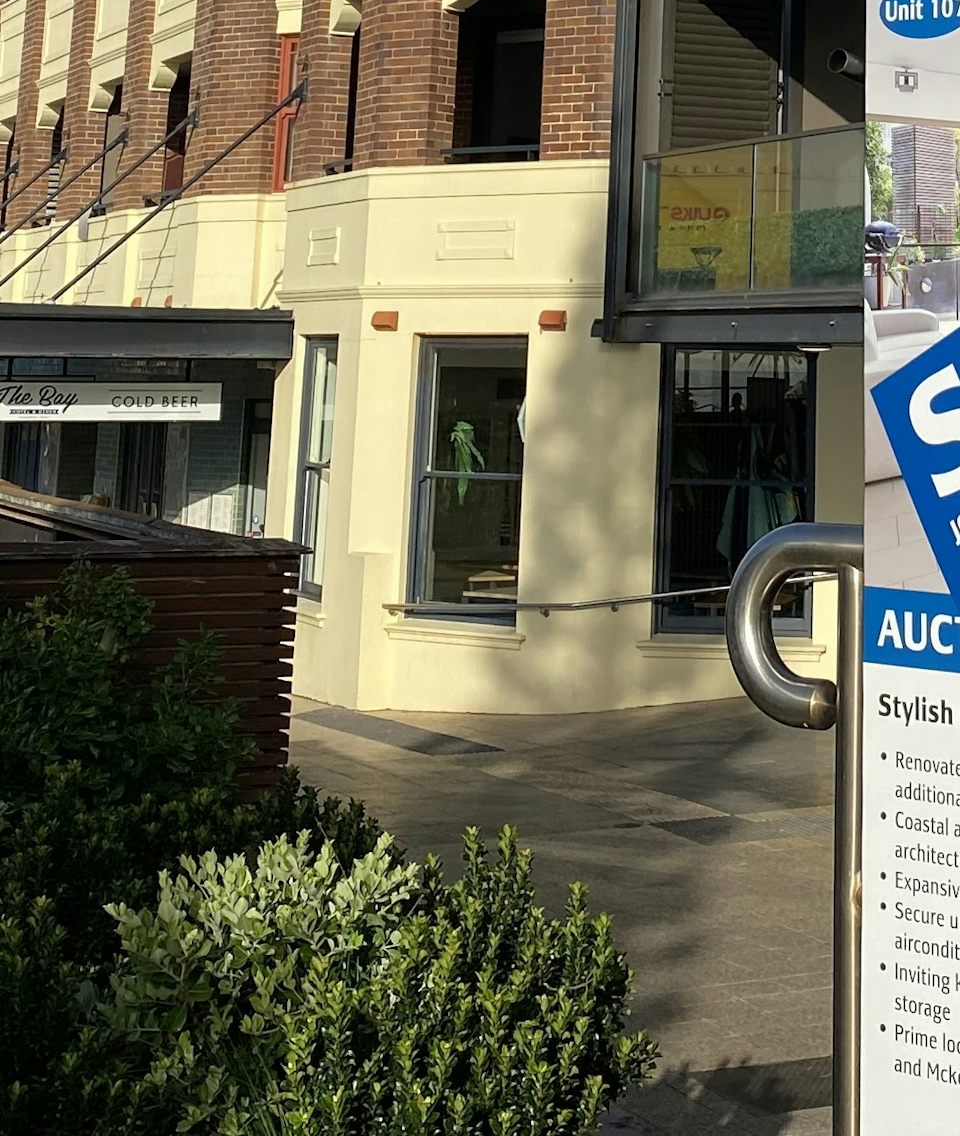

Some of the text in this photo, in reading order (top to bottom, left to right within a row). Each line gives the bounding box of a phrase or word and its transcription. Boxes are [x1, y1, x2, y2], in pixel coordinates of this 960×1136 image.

[0, 385, 78, 413] The Bay
[111, 396, 198, 407] COLD BEER
[879, 694, 952, 727] Stylish
[896, 812, 948, 835] Coastal
[895, 902, 944, 926] Secure
[896, 963, 950, 994] Inviting
[895, 996, 950, 1024] storage
[896, 1024, 937, 1049] Prime
[895, 1059, 921, 1077] and
